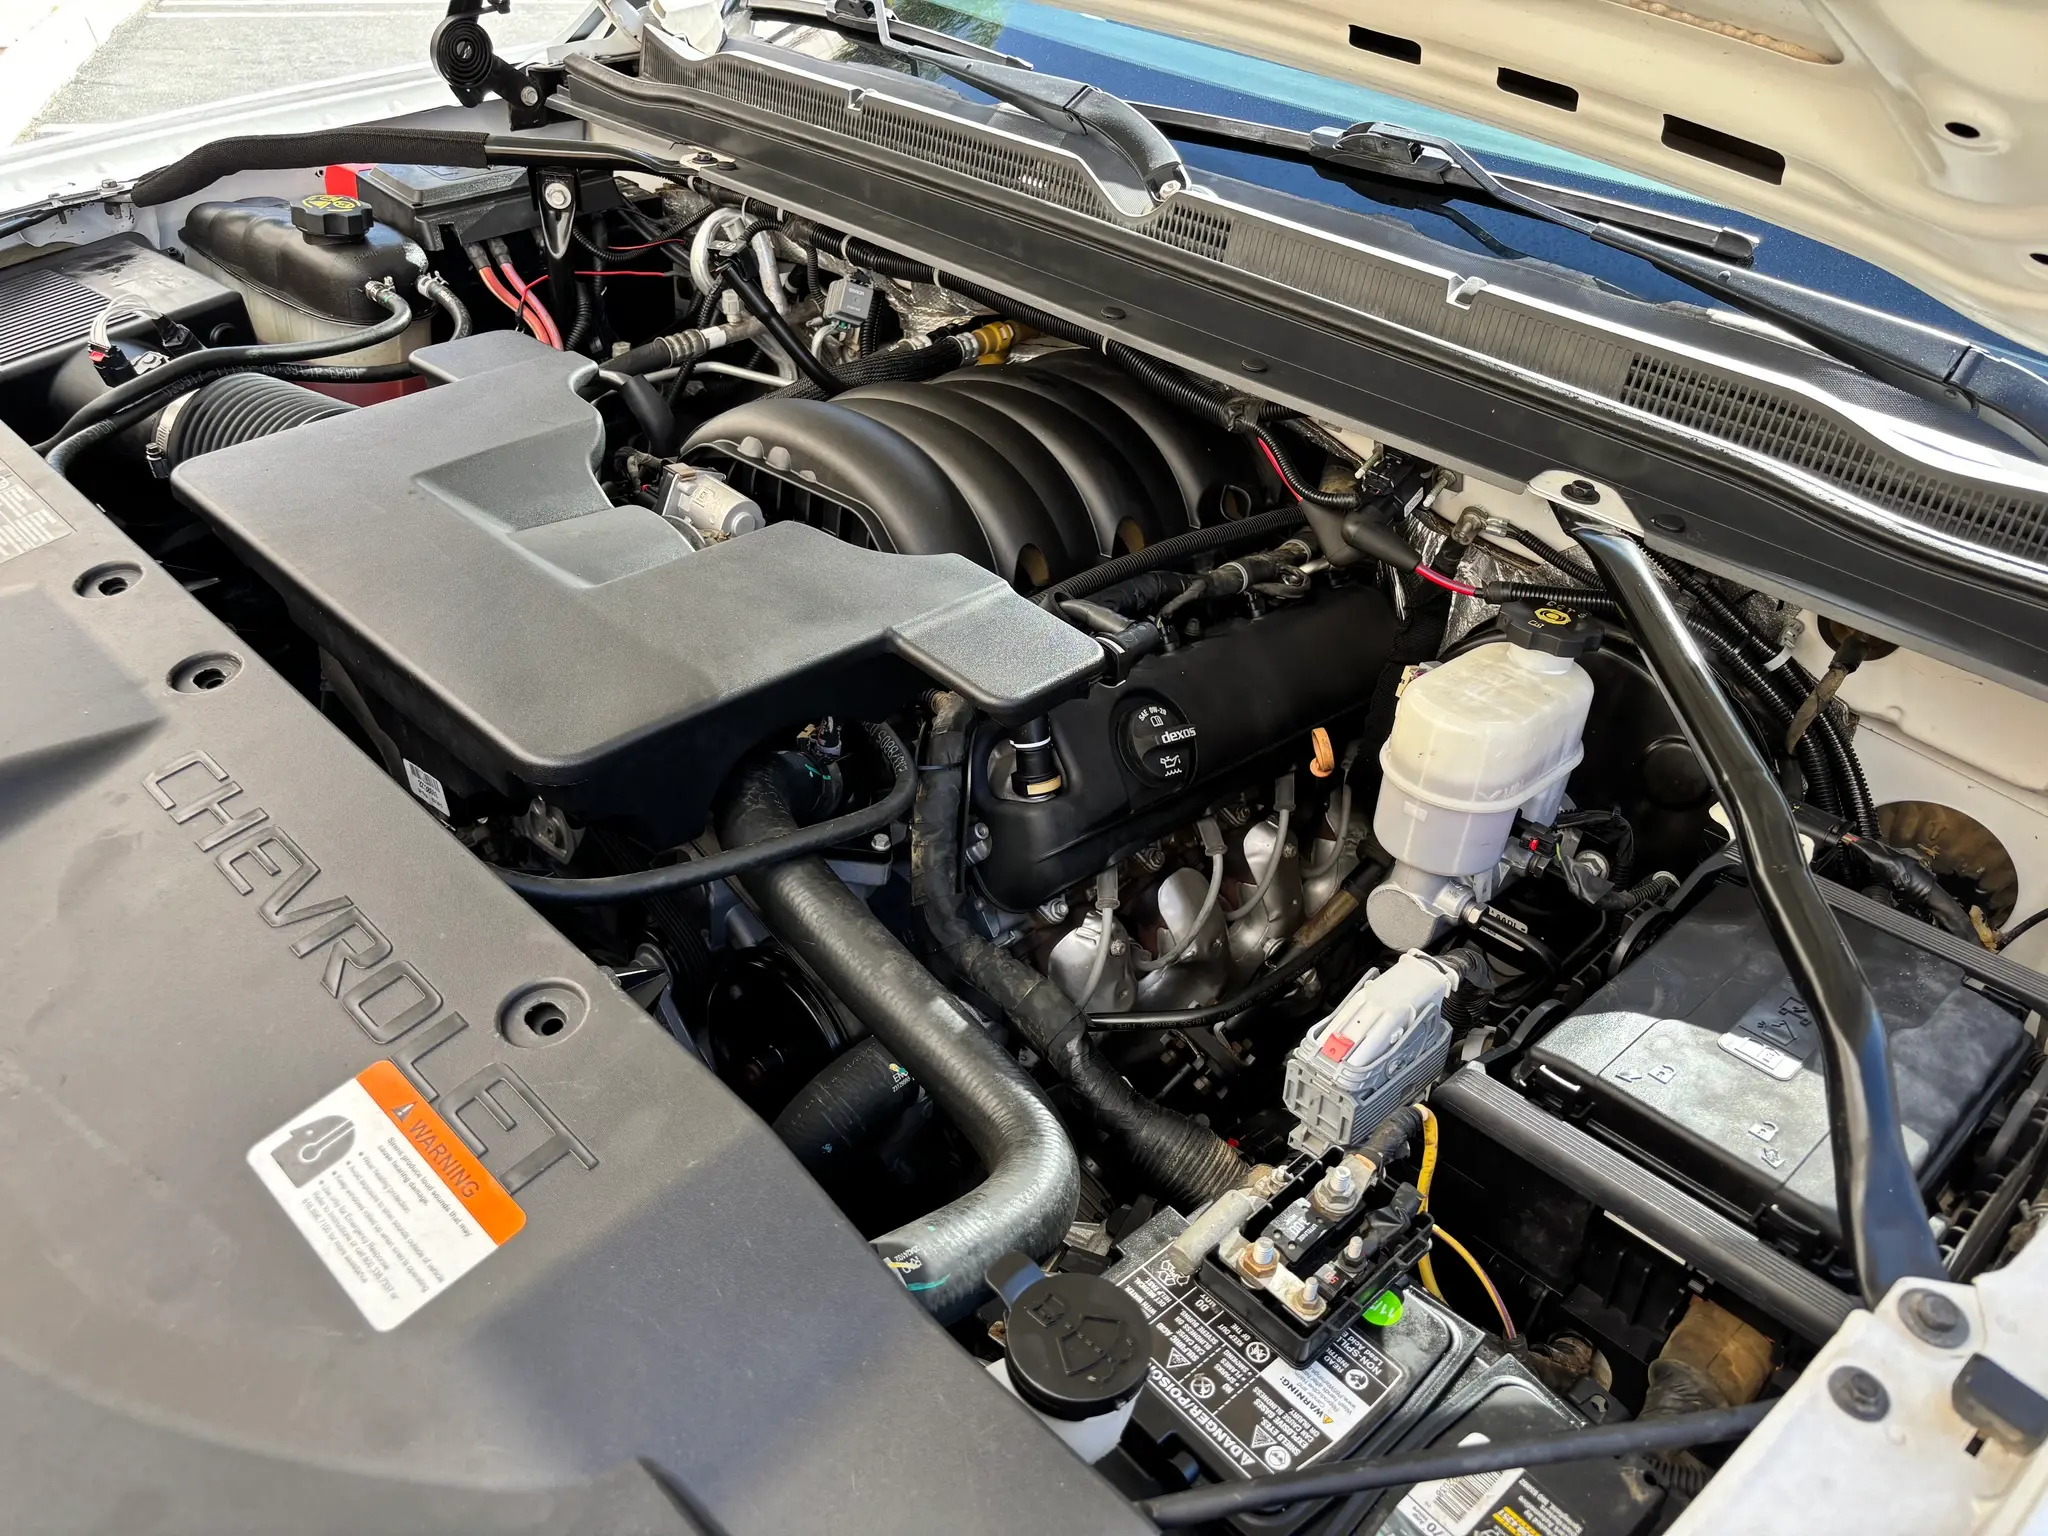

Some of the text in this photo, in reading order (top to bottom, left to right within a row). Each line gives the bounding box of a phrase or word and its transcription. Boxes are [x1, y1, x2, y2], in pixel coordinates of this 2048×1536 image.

[1138, 706, 1167, 721] SAE 0W-20
[1161, 726, 1197, 744] dexos
[141, 749, 600, 1197] CHEVROLET
[406, 1118, 482, 1200] WARNING
[376, 1143, 431, 1207] cause hearing damage.
[385, 1136, 473, 1238] Sirens produce loud sounds that may
[1131, 1275, 1158, 1299] MEDICAL
[1155, 1288, 1172, 1304] HELP
[1139, 1299, 1158, 1316] WITH
[1152, 1295, 1167, 1308] GET
[1193, 1297, 1210, 1313] DO
[1154, 1320, 1200, 1363] SULFURIC ACID
[1173, 1314, 1213, 1351] BLINDNESS OR
[1174, 1326, 1206, 1356] CAN CAUSE
[1195, 1324, 1219, 1346] SEVERE
[1215, 1321, 1245, 1348] KEEP OUT
[1228, 1321, 1251, 1342] OF THE
[1346, 1334, 1365, 1351] Acid
[1218, 1356, 1244, 1379] FLAMES
[1221, 1347, 1250, 1374] SMOKING
[1321, 1353, 1345, 1374] READ
[1362, 1347, 1384, 1366] Lead
[1212, 1361, 1237, 1385] SPARKS
[1220, 1381, 1235, 1395] NO
[1277, 1374, 1325, 1418] WARNING:
[1251, 1384, 1315, 1443] CAN CAUSE BLINDNESS
[1251, 1396, 1309, 1450] EXPLOSIVE GASES
[1286, 1406, 1321, 1438] OR INJURY.
[1275, 1432, 1302, 1456] SHIELD
